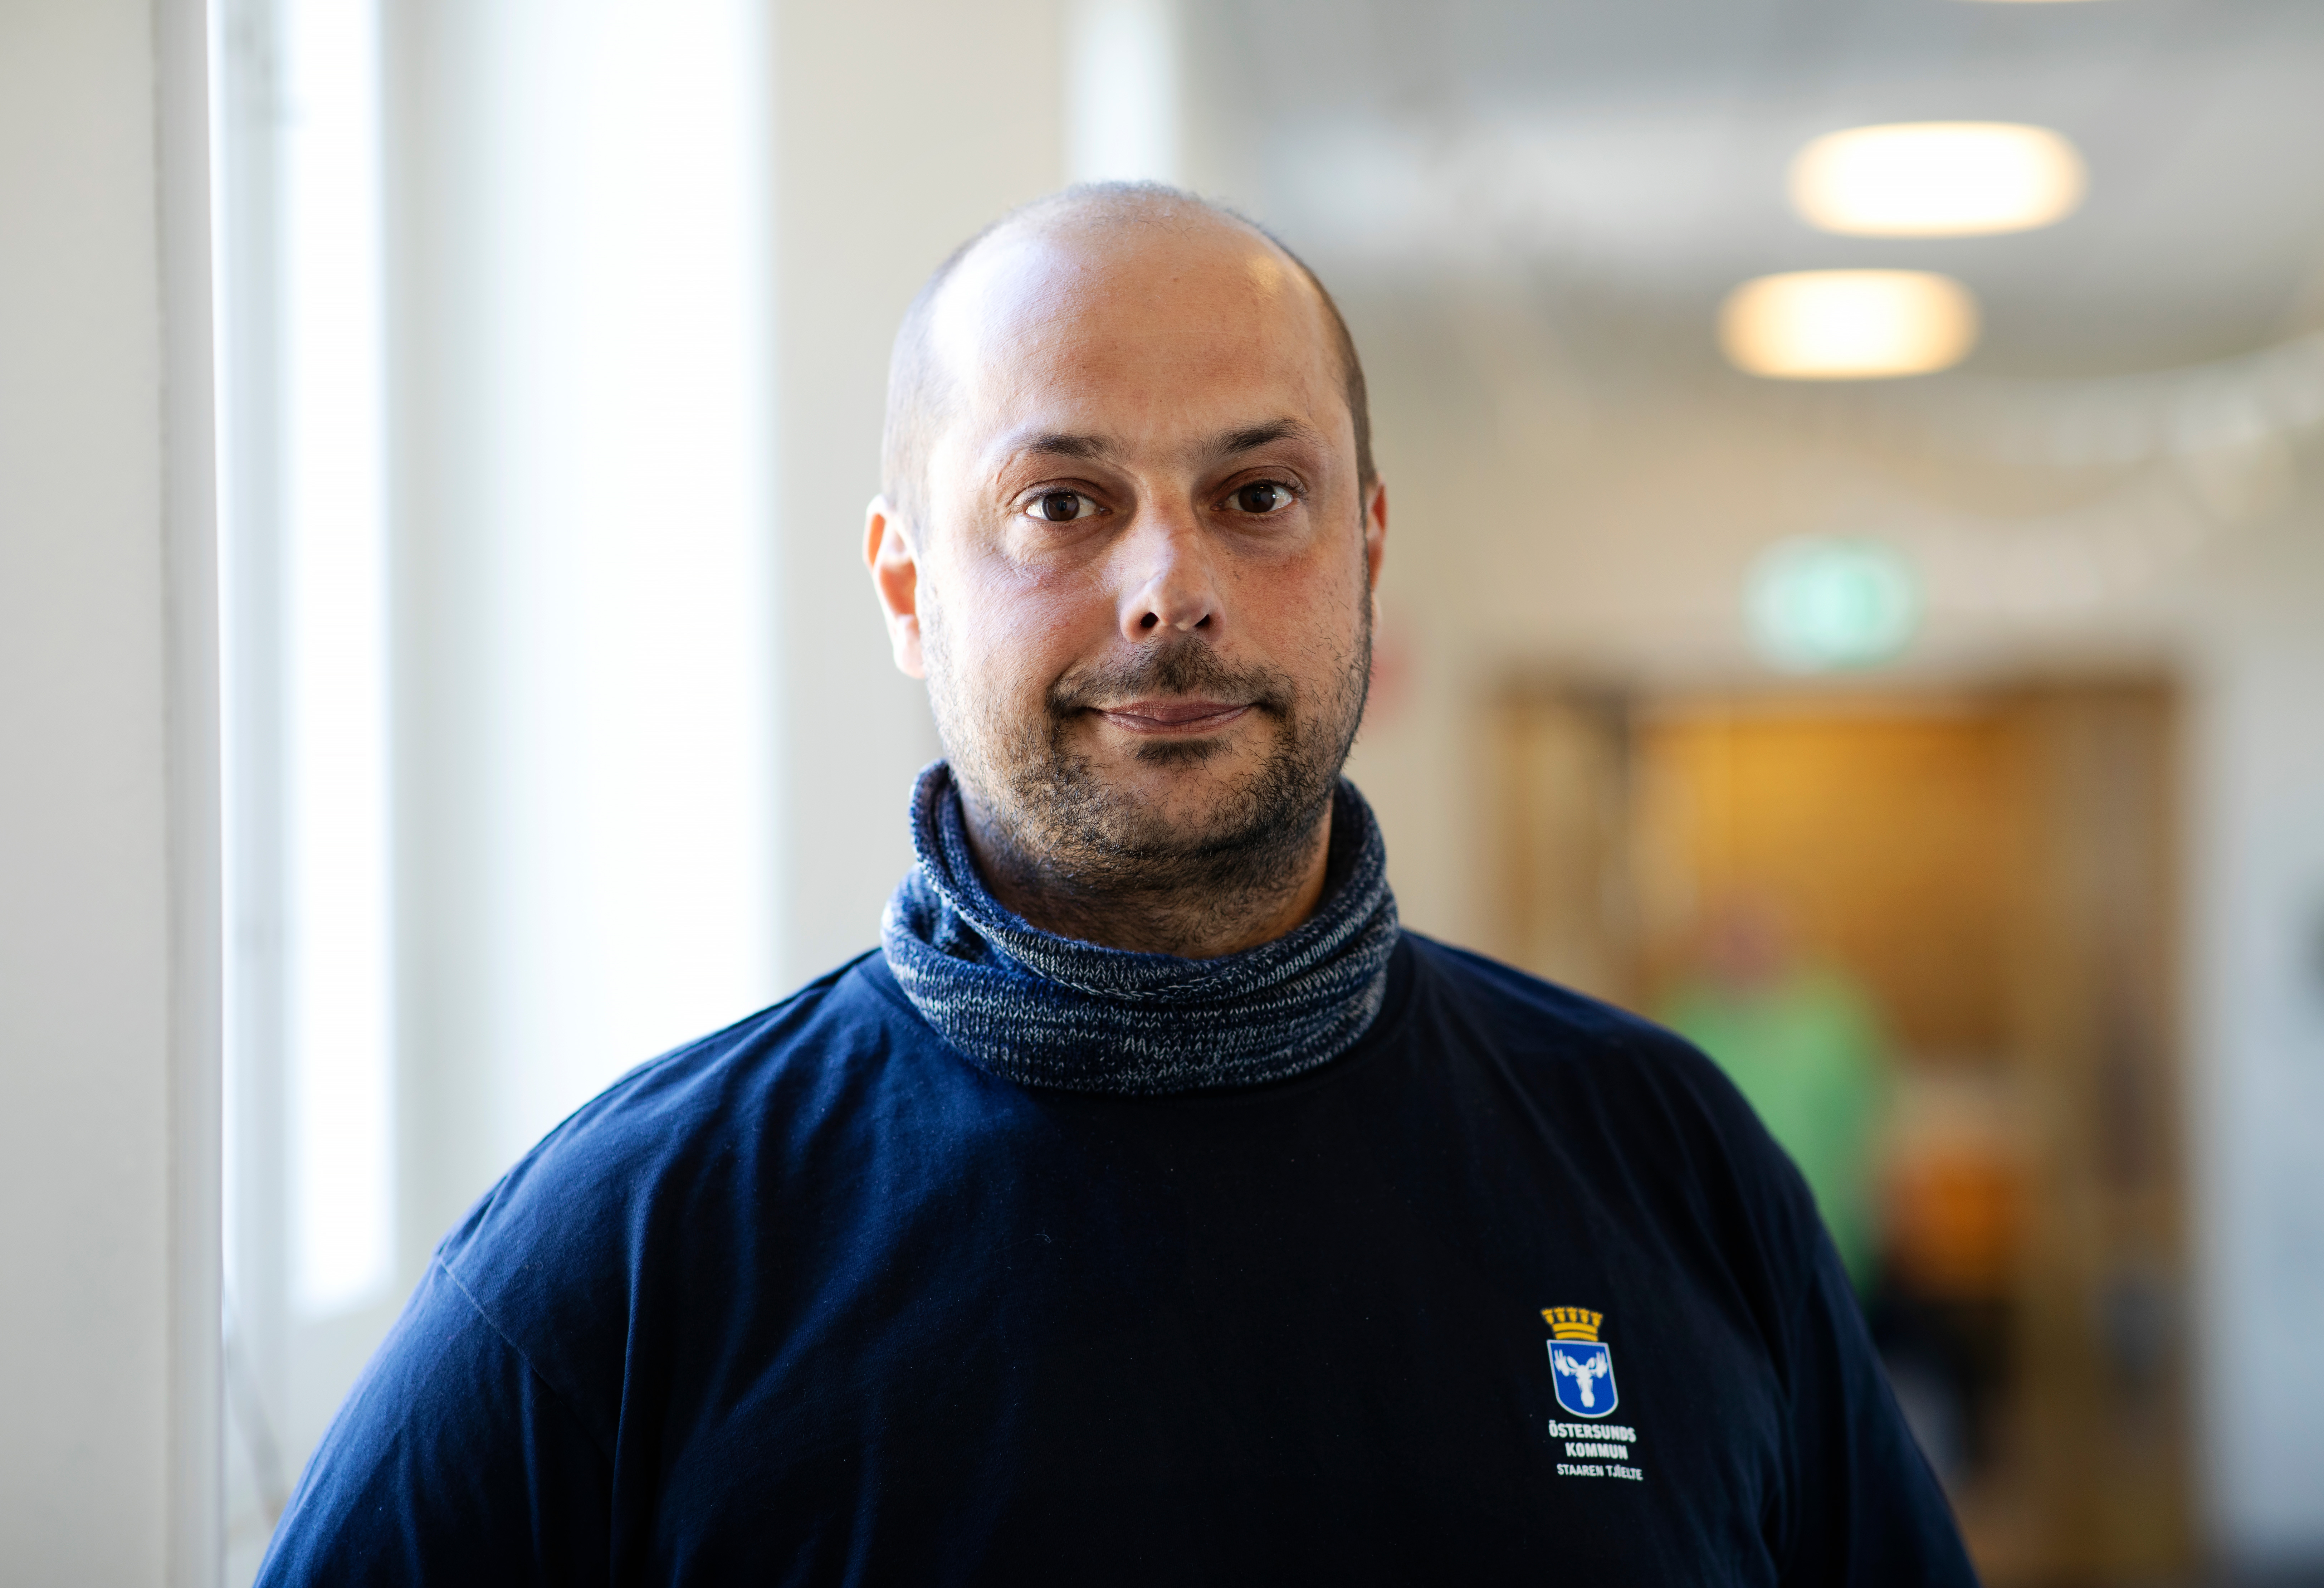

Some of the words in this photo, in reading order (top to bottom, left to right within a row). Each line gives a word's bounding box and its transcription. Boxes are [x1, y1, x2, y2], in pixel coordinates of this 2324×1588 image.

[1548, 1420, 1637, 1443] ÖSTERSUNDS
[1565, 1442, 1629, 1460] KOMMUN
[1557, 1463, 1605, 1477] STAAREN
